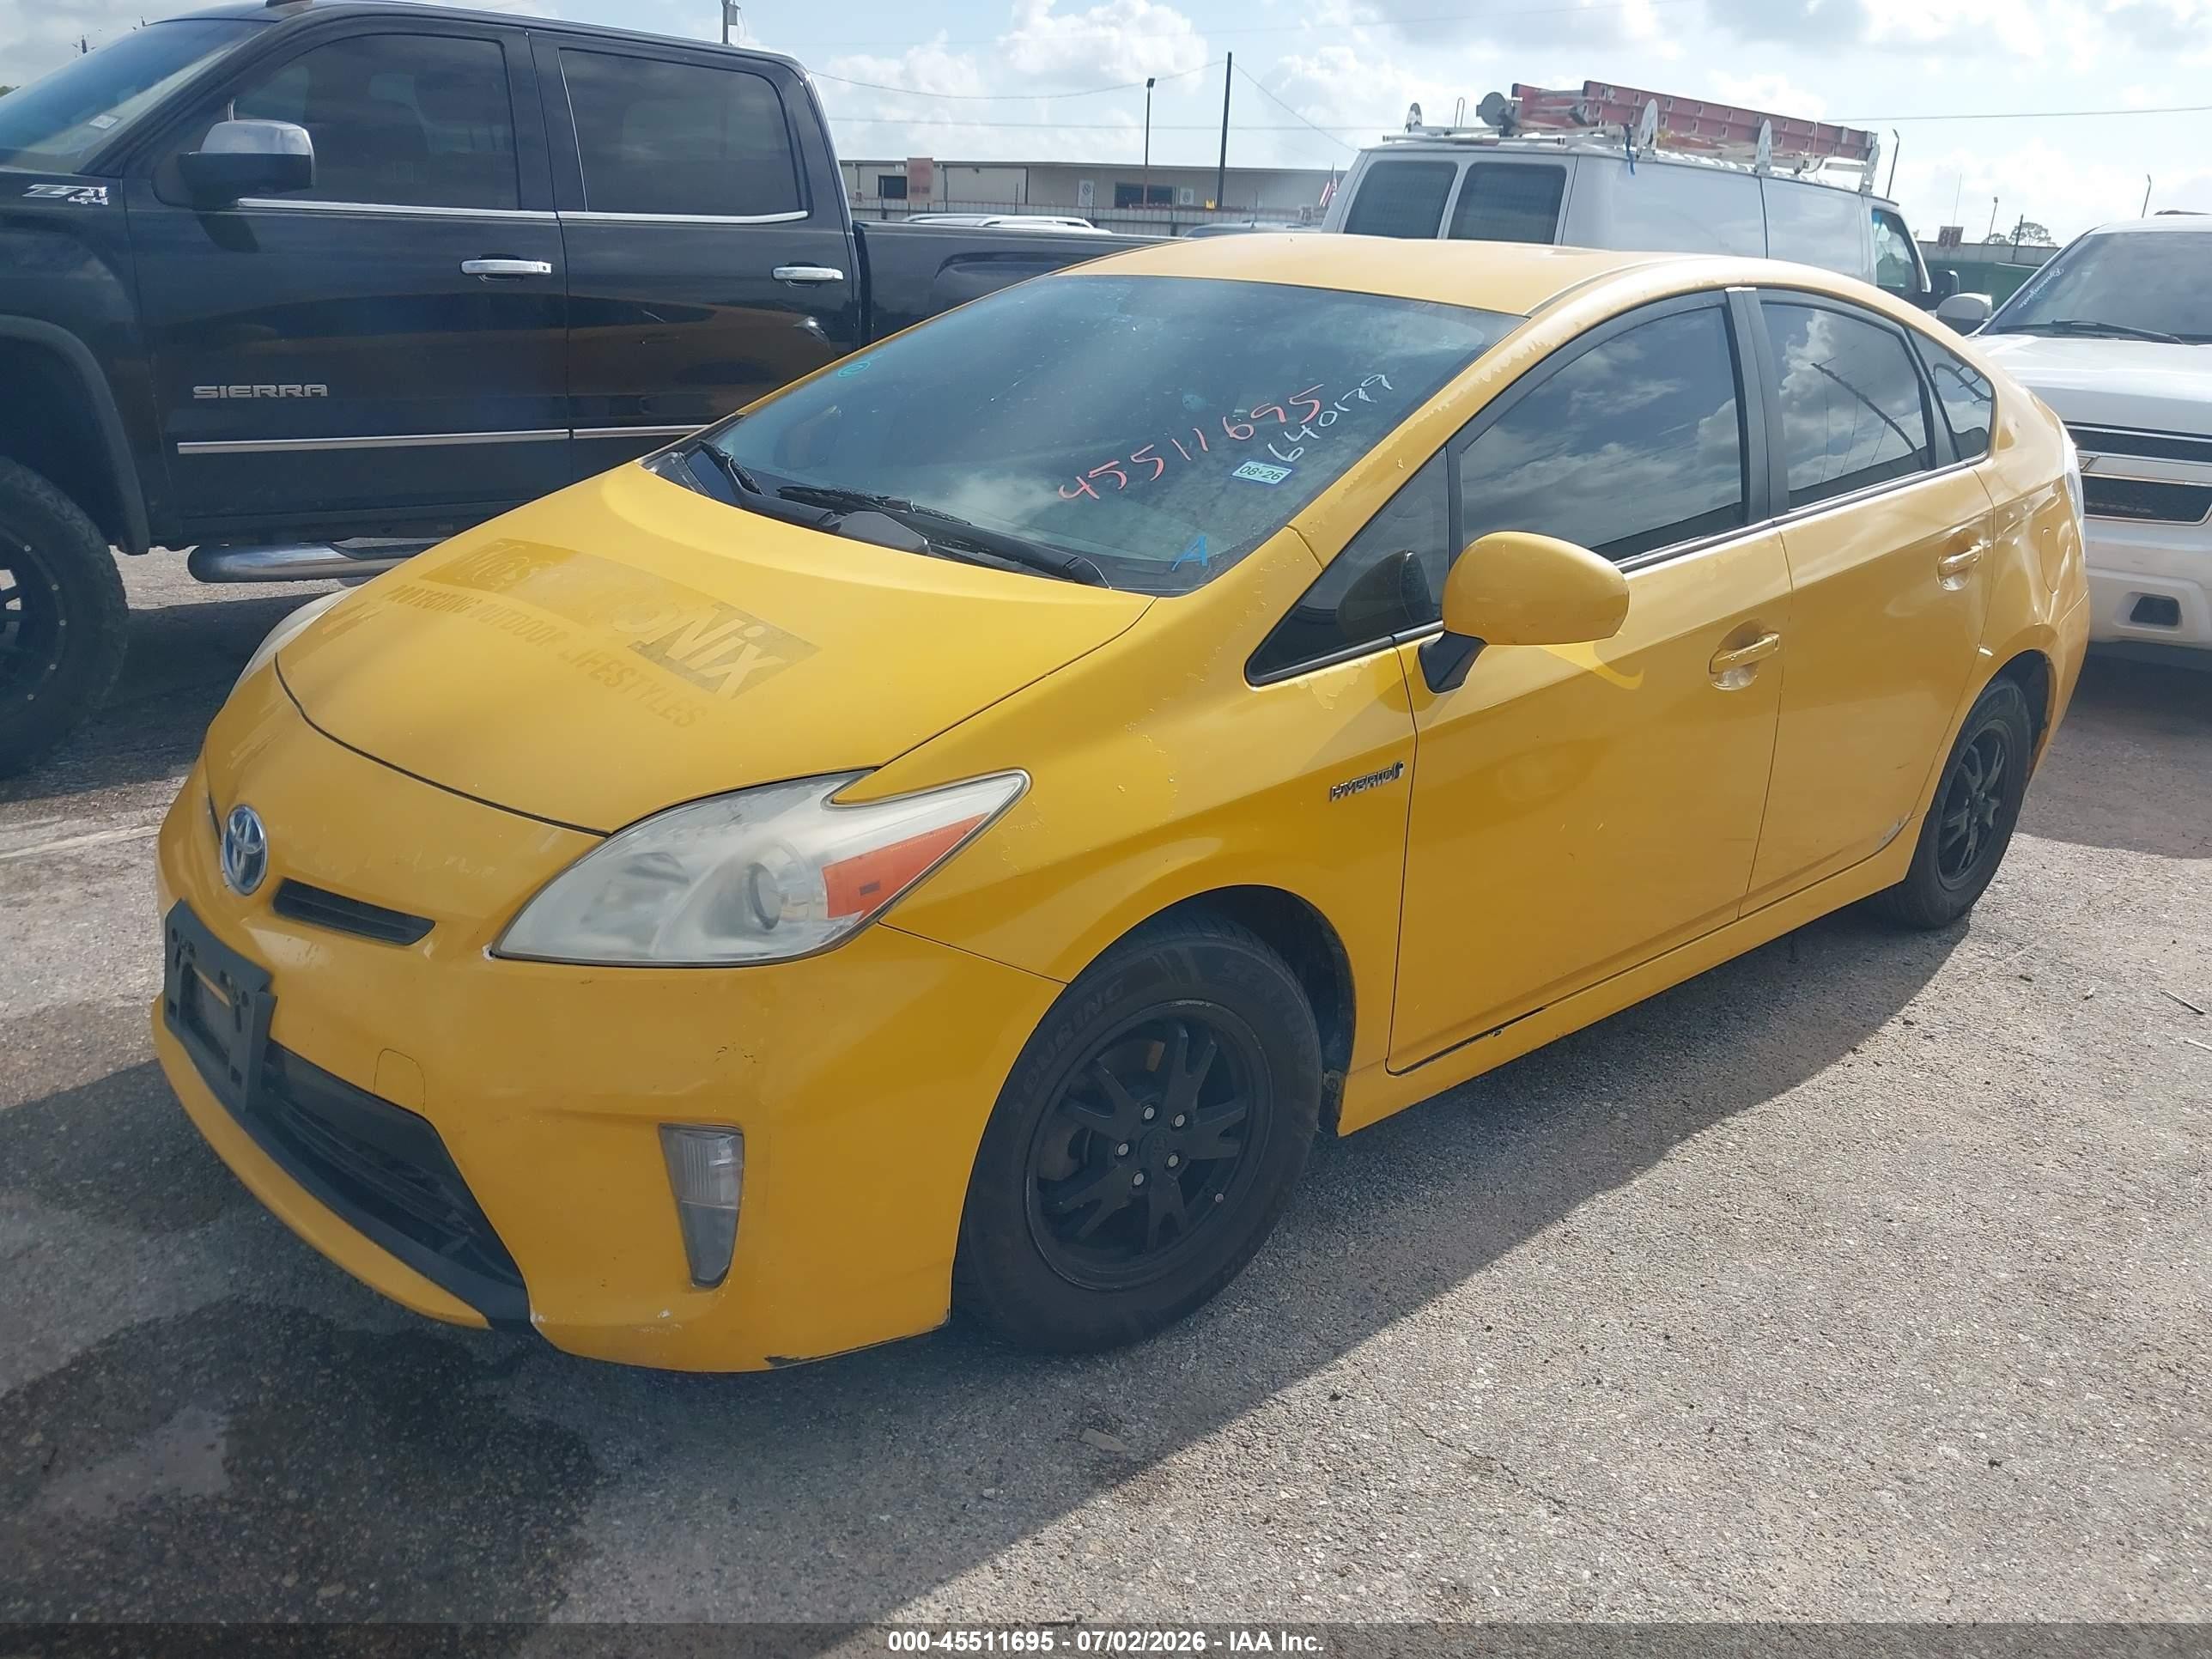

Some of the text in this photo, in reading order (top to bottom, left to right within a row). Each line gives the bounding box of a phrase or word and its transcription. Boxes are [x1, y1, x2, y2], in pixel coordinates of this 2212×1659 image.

[192, 384, 328, 399] SIERRA
[1267, 374, 1394, 463] 640179
[1057, 383, 1325, 500] 45511695
[1170, 535, 1209, 573] A
[1329, 766, 1396, 802] HYBRID
